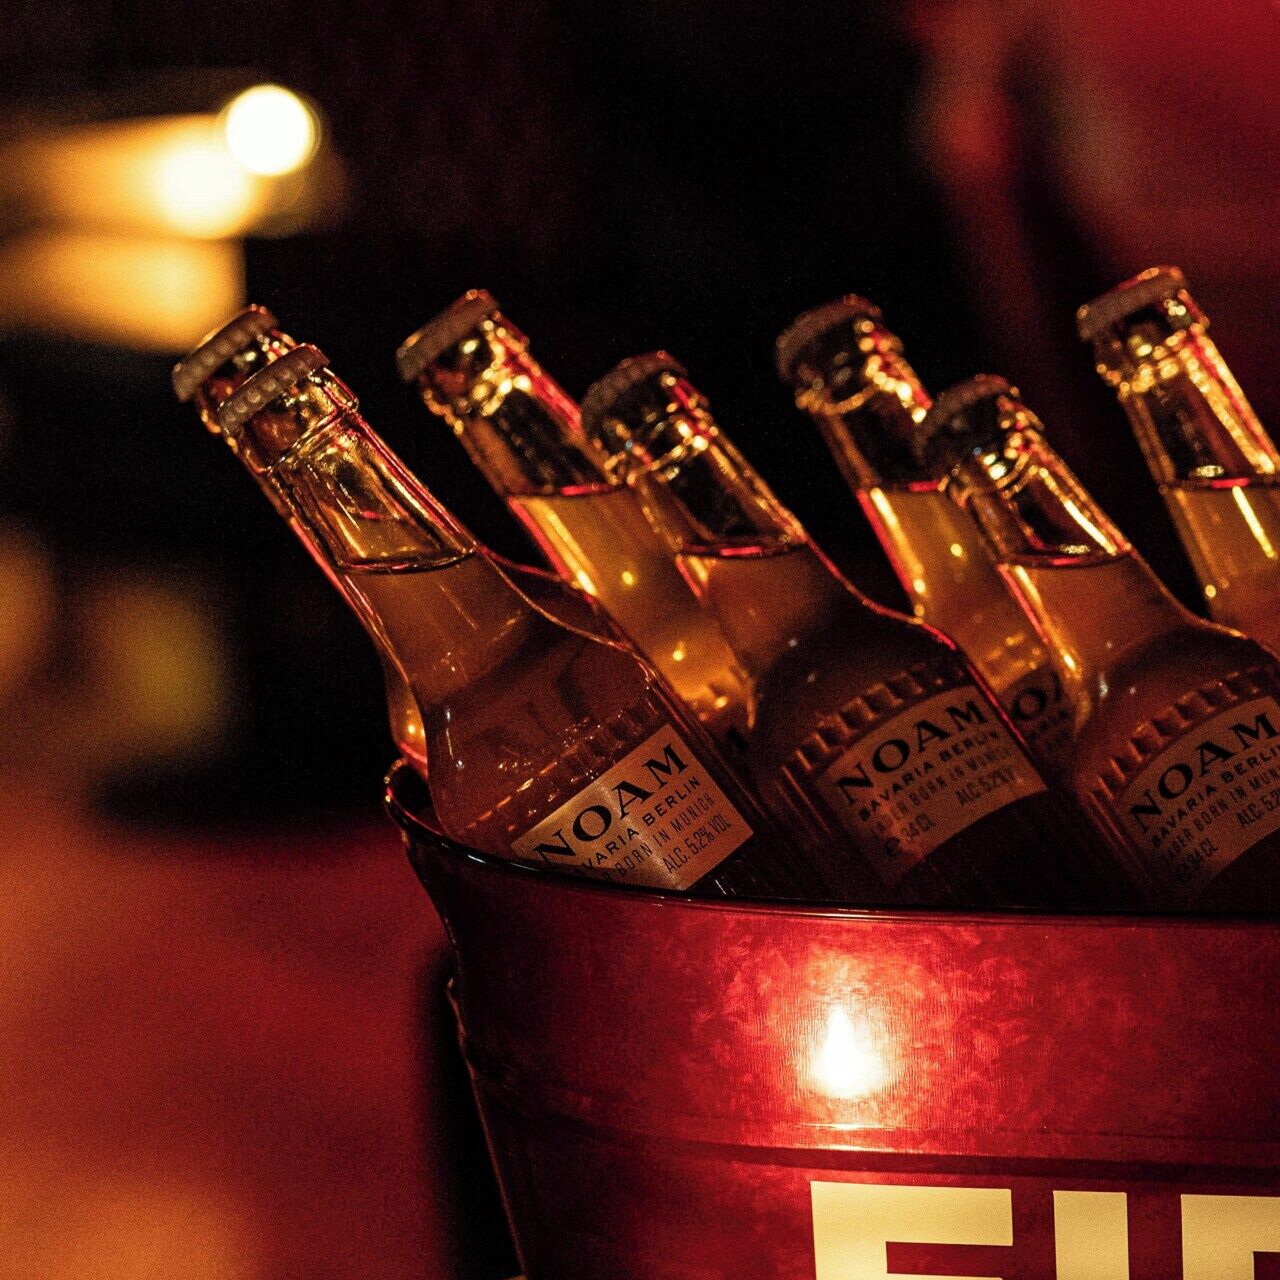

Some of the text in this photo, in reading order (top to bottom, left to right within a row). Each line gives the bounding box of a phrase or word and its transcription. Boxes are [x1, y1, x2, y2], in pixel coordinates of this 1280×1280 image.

[837, 701, 987, 804] NOAM
[1129, 712, 1280, 833] NOAM
[533, 743, 688, 867] NOAM
[580, 776, 700, 870] VARIA BERLIN
[615, 844, 653, 876] BORN
[653, 829, 671, 847] IN
[670, 792, 715, 834] MUNICH
[662, 813, 732, 874] ALC. 5.2% VOL
[1151, 785, 1217, 848] BAVARIA
